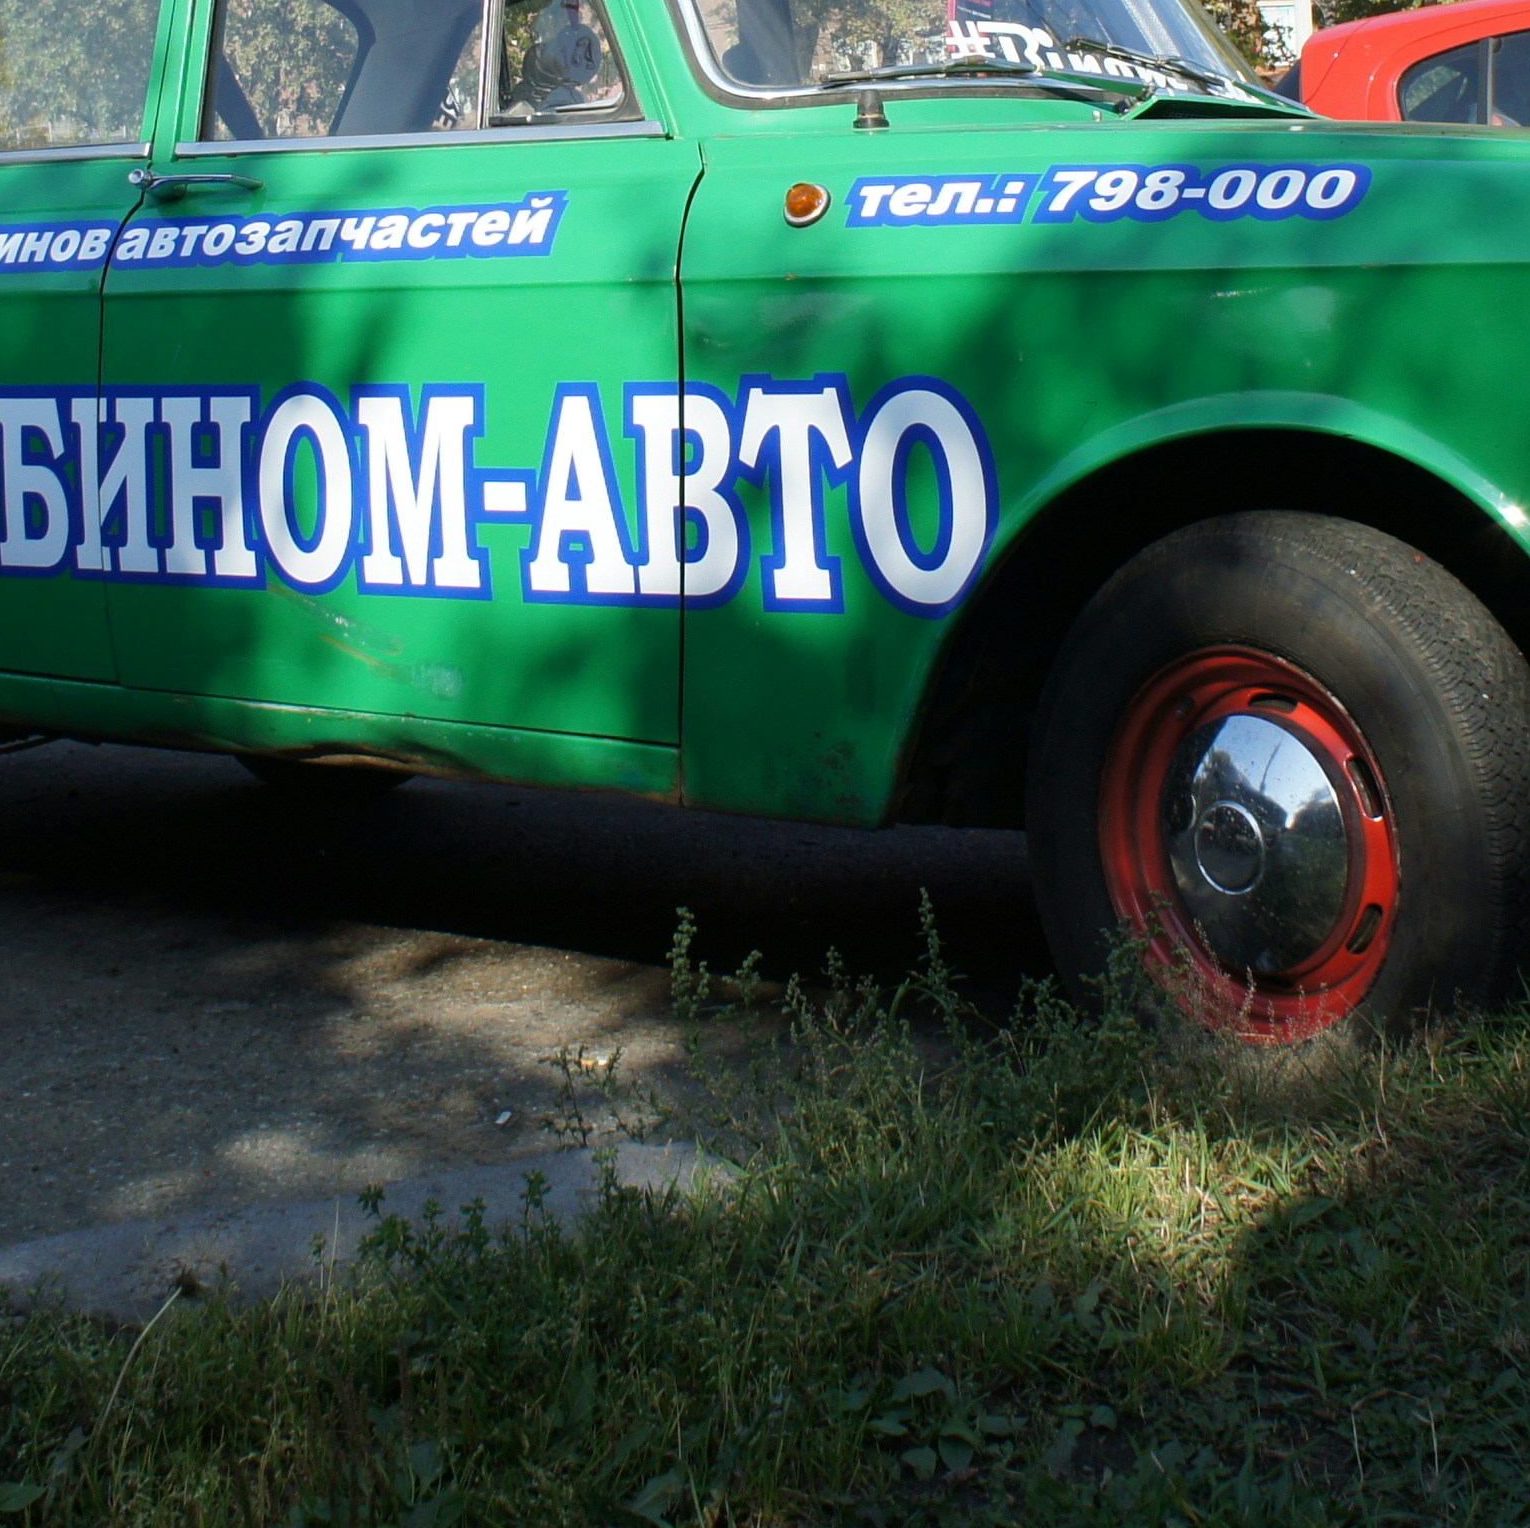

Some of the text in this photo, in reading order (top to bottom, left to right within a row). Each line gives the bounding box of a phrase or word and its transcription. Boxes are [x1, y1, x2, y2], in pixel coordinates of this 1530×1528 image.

[859, 168, 1359, 217] тел.: 798-000
[115, 198, 560, 262] автозапчастей
